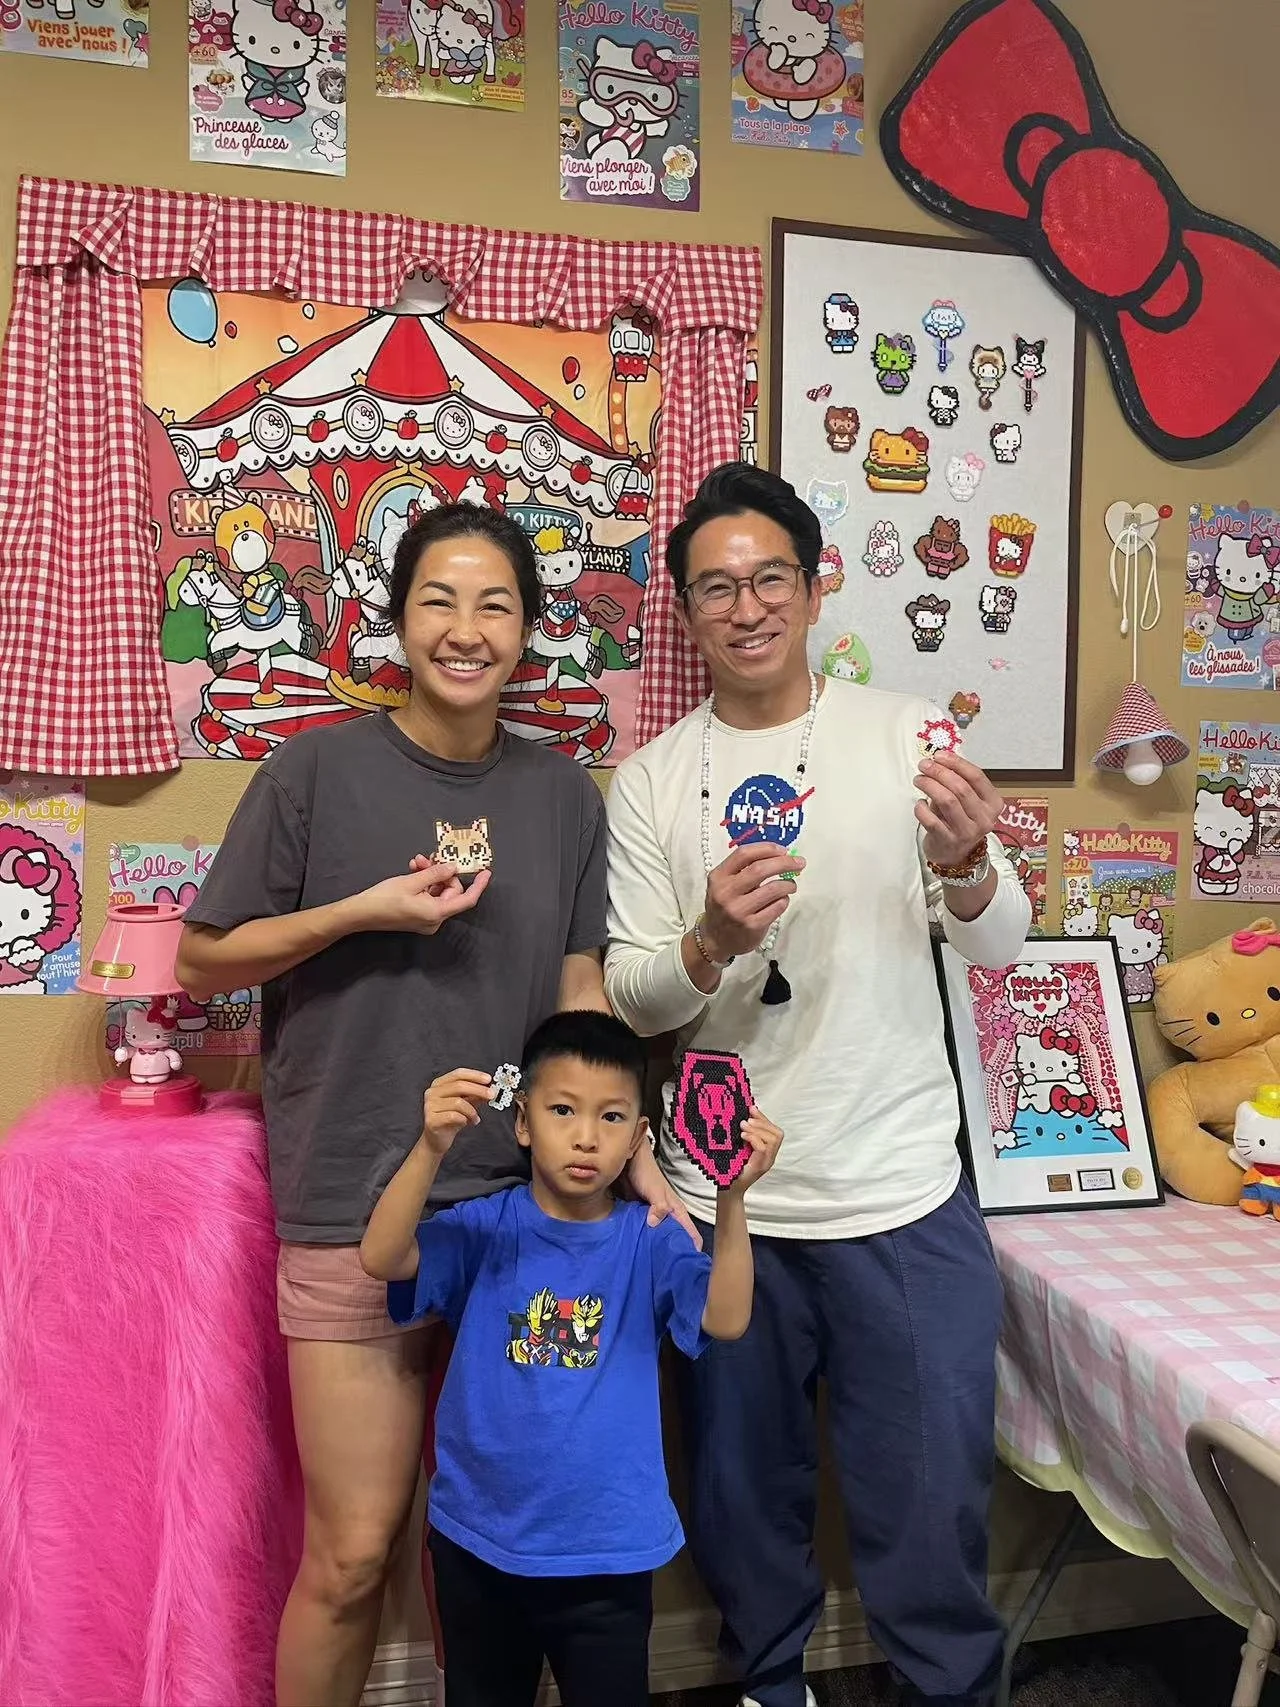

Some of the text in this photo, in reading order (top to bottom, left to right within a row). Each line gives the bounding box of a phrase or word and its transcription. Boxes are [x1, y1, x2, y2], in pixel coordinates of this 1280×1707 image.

[28, 19, 115, 42] Viens jouer
[559, 2, 625, 28] Hello
[632, 2, 699, 52] Kitty
[38, 35, 127, 53] avec nous !
[193, 47, 216, 57] +60
[561, 90, 574, 99] 85
[193, 117, 262, 134] Princesse
[740, 118, 811, 134] Tous à la plage
[214, 133, 289, 156] des glaces
[595, 157, 649, 180] plonger
[588, 179, 617, 192] avec
[619, 178, 647, 192] moi
[648, 176, 653, 190] !
[530, 512, 572, 528] KITTY
[1189, 514, 1246, 541] Hello
[1217, 648, 1244, 661] nous
[1189, 658, 1260, 681] les glissades !
[1202, 728, 1258, 750] Hello
[14, 792, 84, 835] Kitty
[732, 803, 800, 828] NASA
[1081, 832, 1172, 862] Hello Kitty
[109, 854, 187, 887] Hello
[51, 954, 73, 964] Pour
[1010, 975, 1063, 989] HELLO
[1012, 988, 1064, 1002] KITTY
